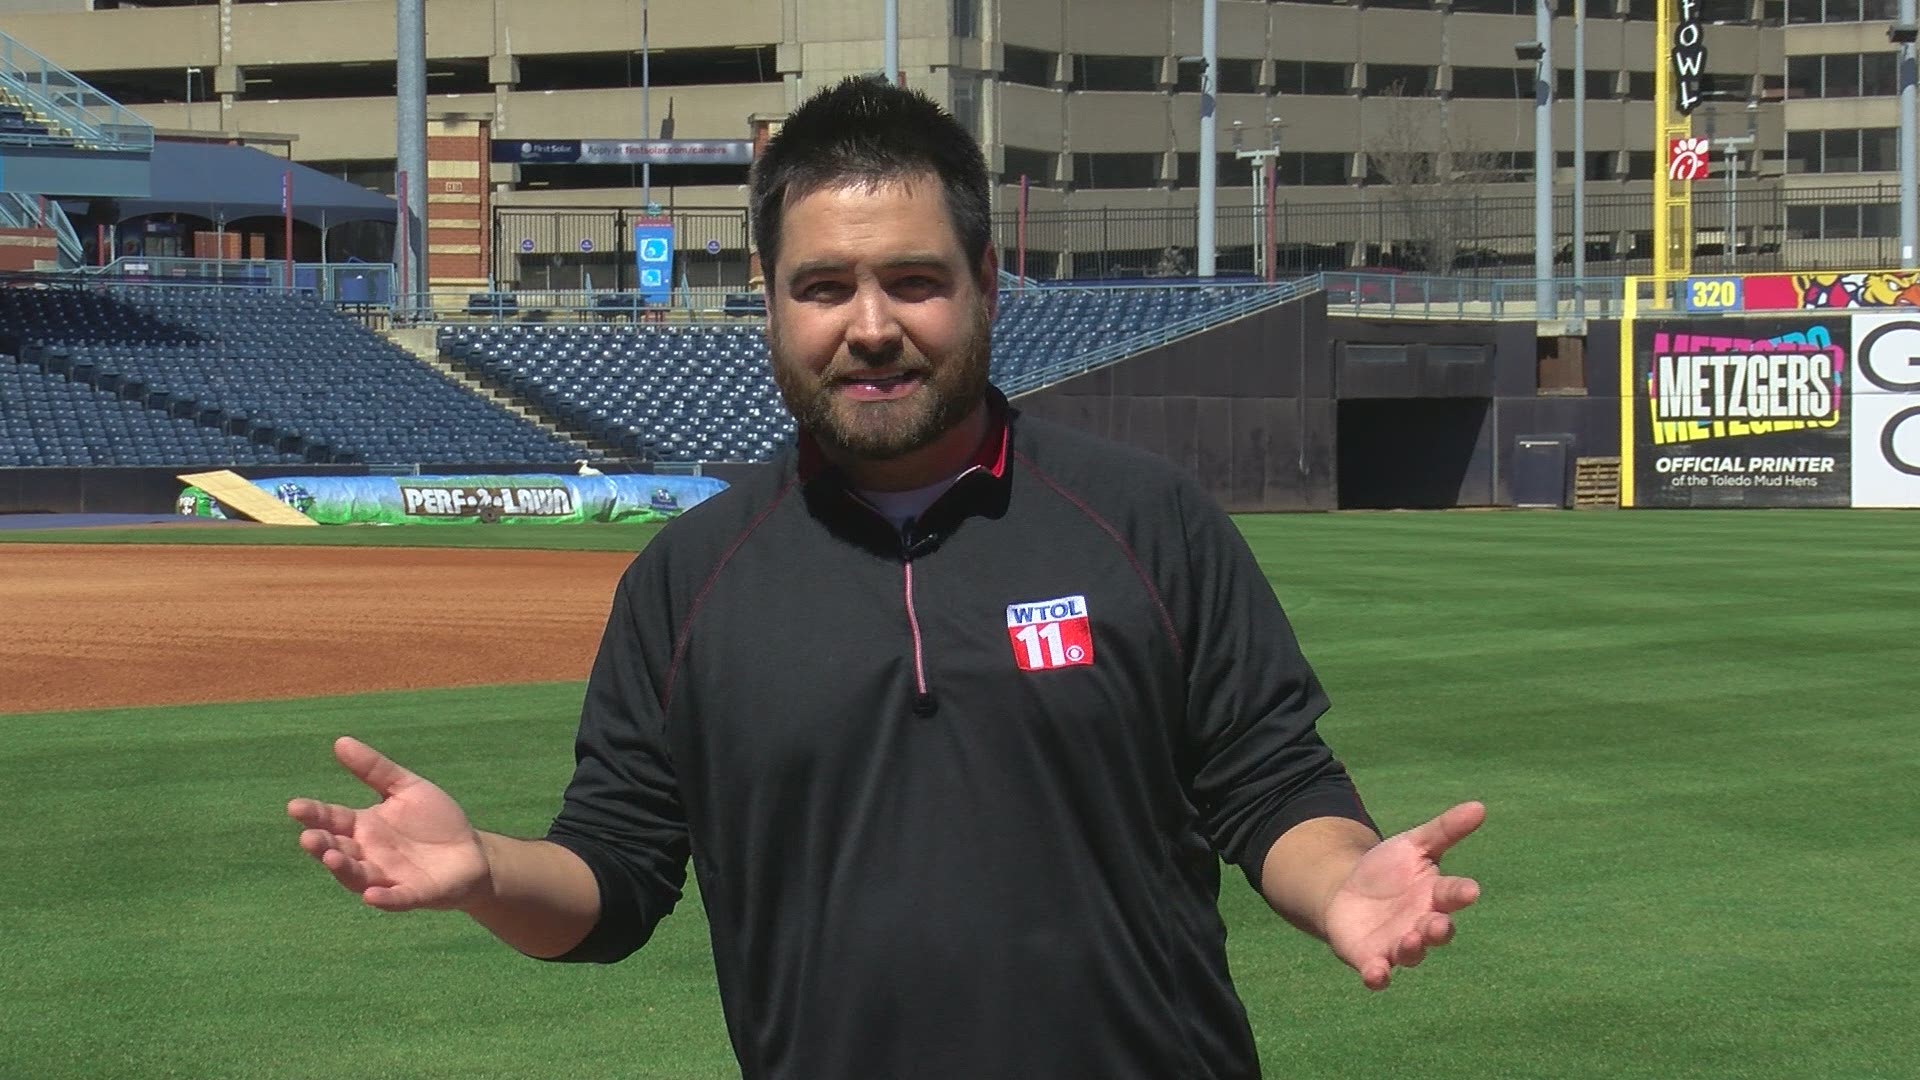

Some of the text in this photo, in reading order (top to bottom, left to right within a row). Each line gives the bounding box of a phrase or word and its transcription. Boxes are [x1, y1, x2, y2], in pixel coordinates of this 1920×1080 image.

[1676, 0, 1702, 109] FOWL
[588, 146, 611, 156] Apply
[1692, 280, 1736, 307] 320
[1659, 354, 1831, 418] METZGERS
[1655, 457, 1835, 473] OFFICIAL PRINTER
[1671, 475, 1818, 487] of the Toledo Mud Hens
[1012, 601, 1082, 624] WTOL
[1016, 622, 1066, 669] 11
